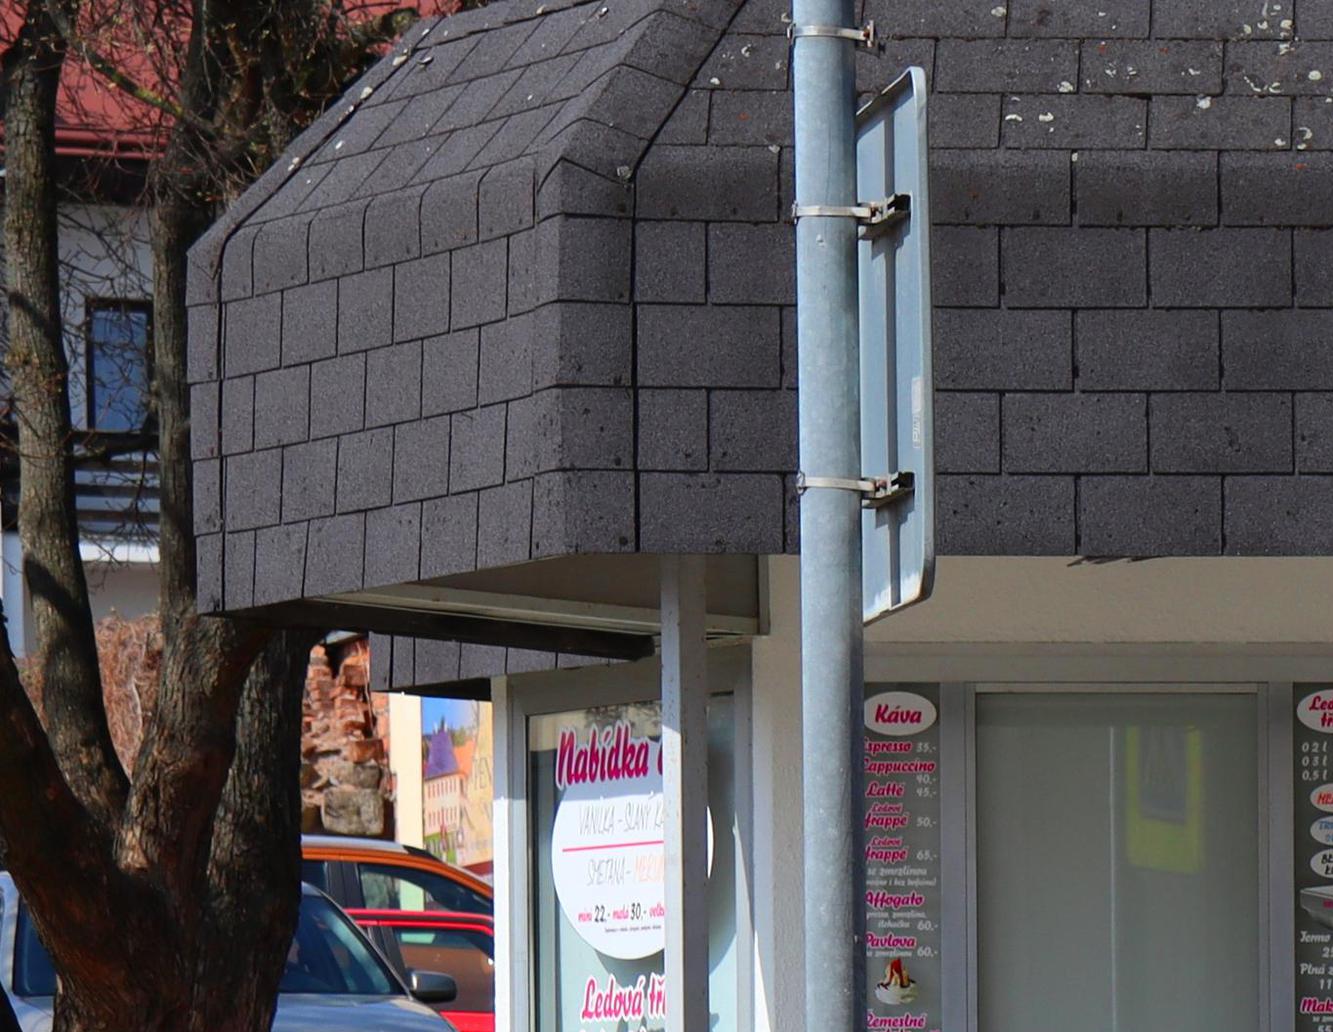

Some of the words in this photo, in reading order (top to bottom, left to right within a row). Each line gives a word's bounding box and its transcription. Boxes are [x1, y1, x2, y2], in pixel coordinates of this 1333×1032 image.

[875, 704, 922, 723] Káva
[557, 721, 650, 786] Nabídka
[864, 738, 912, 756] spresso
[865, 889, 925, 910] Affogato
[582, 977, 643, 1019] Ledová
